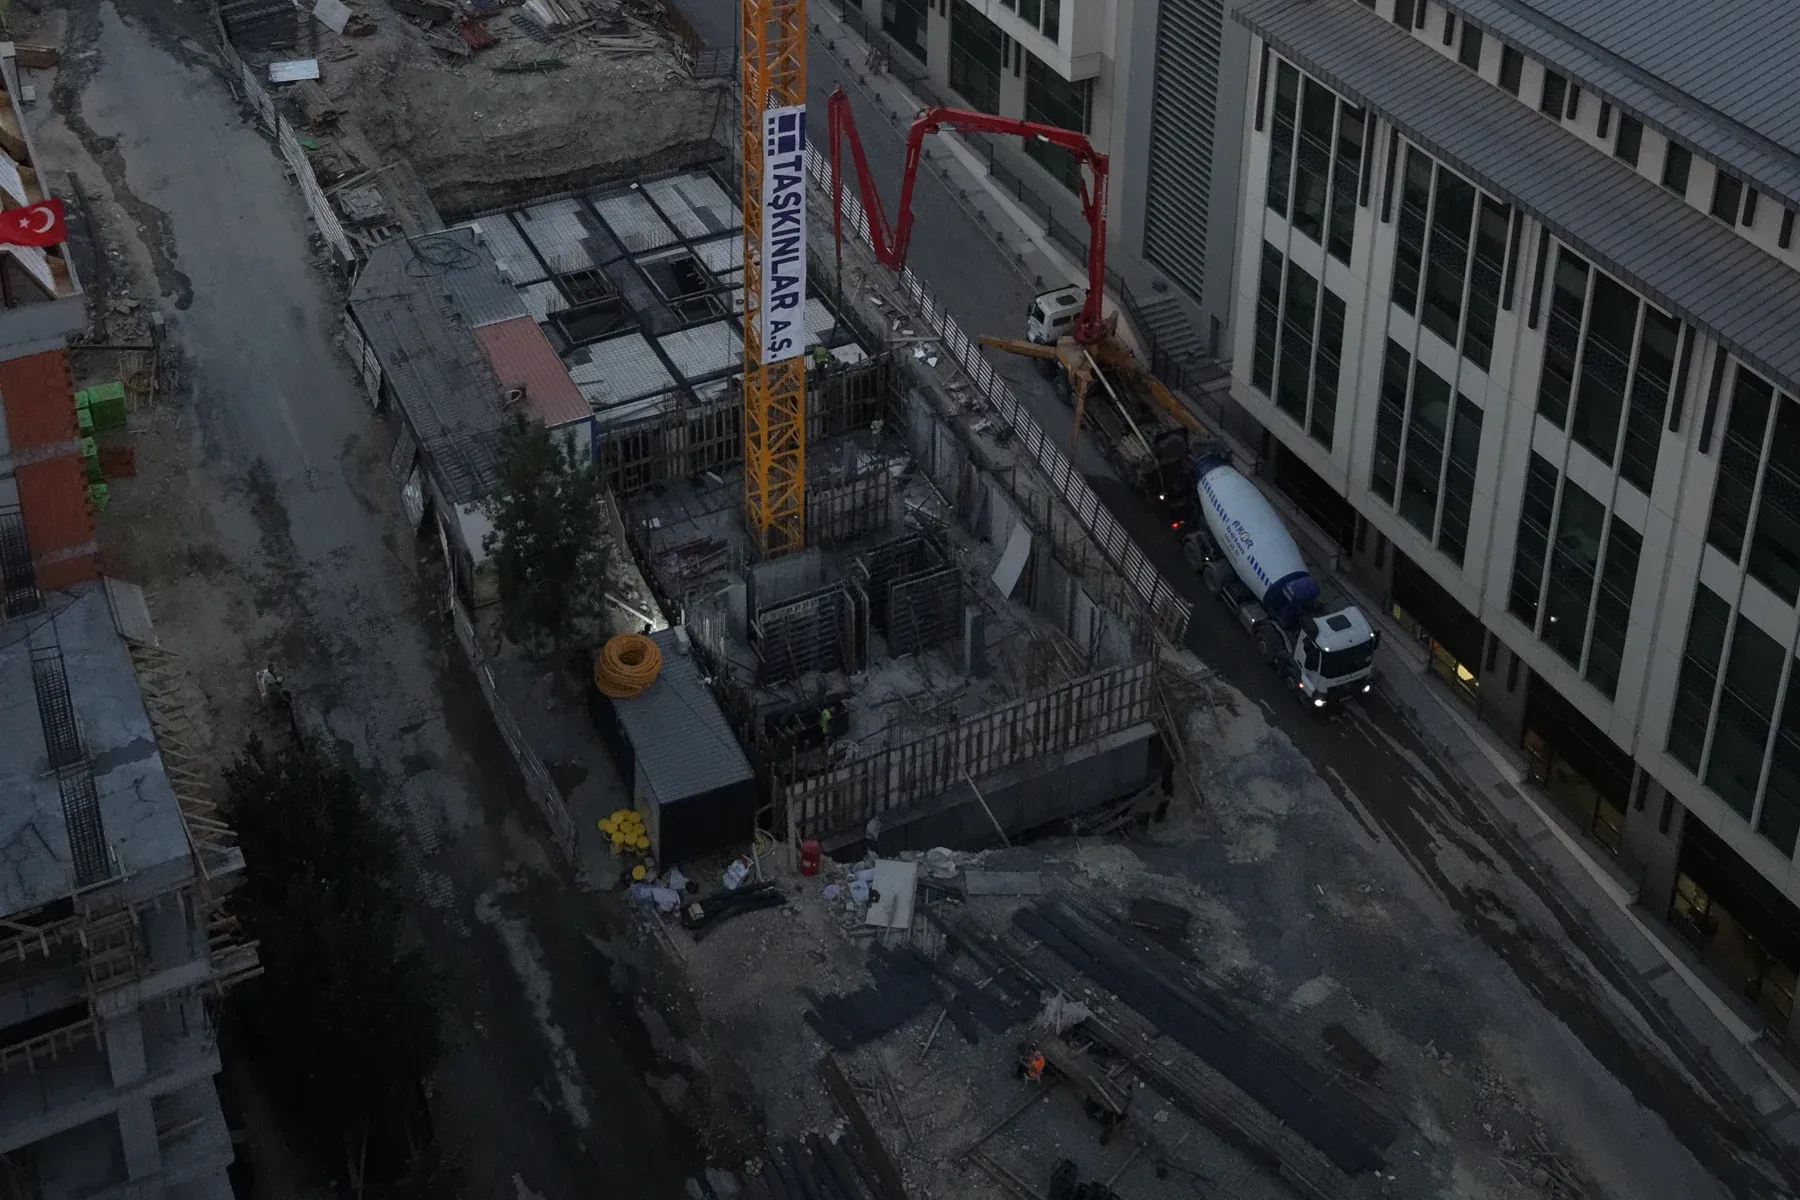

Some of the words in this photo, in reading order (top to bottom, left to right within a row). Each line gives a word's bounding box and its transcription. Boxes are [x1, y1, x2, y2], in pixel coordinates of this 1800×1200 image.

[767, 155, 802, 313] TAŞKINLAR
[767, 320, 792, 359] A.Ş.
[1232, 520, 1254, 550] AKOR
